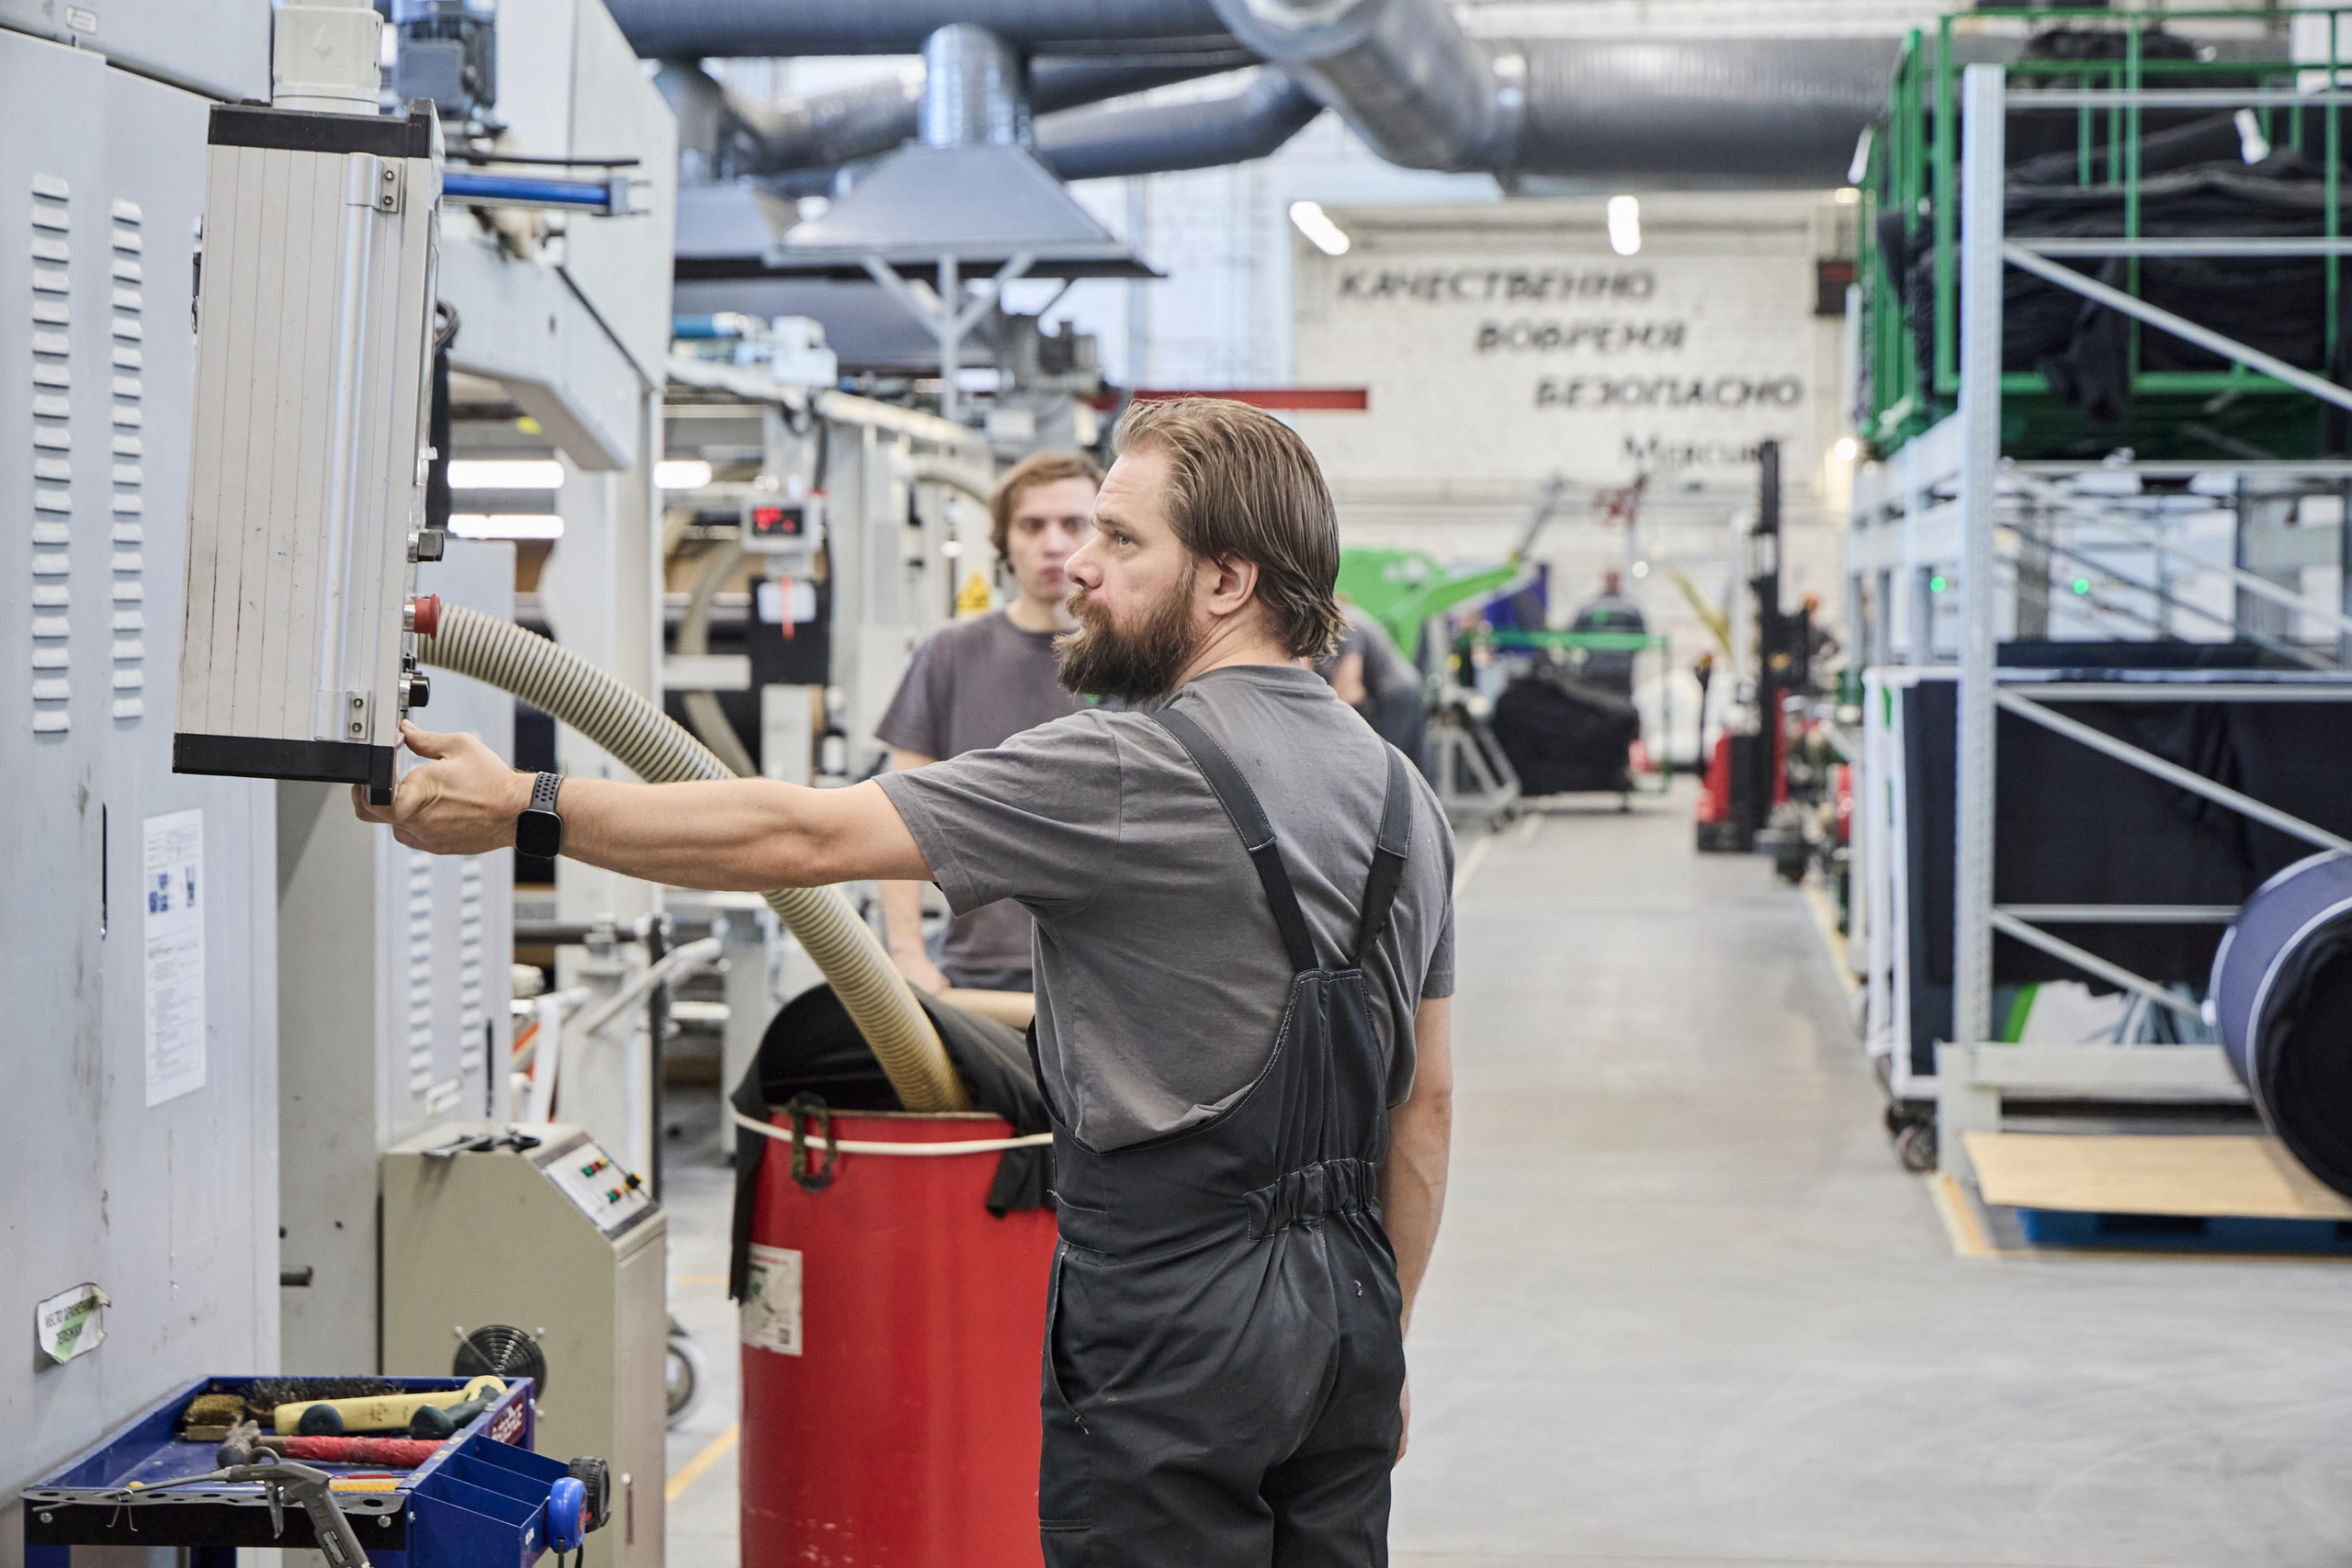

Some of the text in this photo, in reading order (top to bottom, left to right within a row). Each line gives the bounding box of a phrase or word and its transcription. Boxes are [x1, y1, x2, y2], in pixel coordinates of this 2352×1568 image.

[1339, 266, 1657, 301] КАЧЕСТВЕННО
[1476, 320, 1687, 354] ВОВРЕМЯ
[1535, 375, 1804, 409] БЕЗОПАСНО
